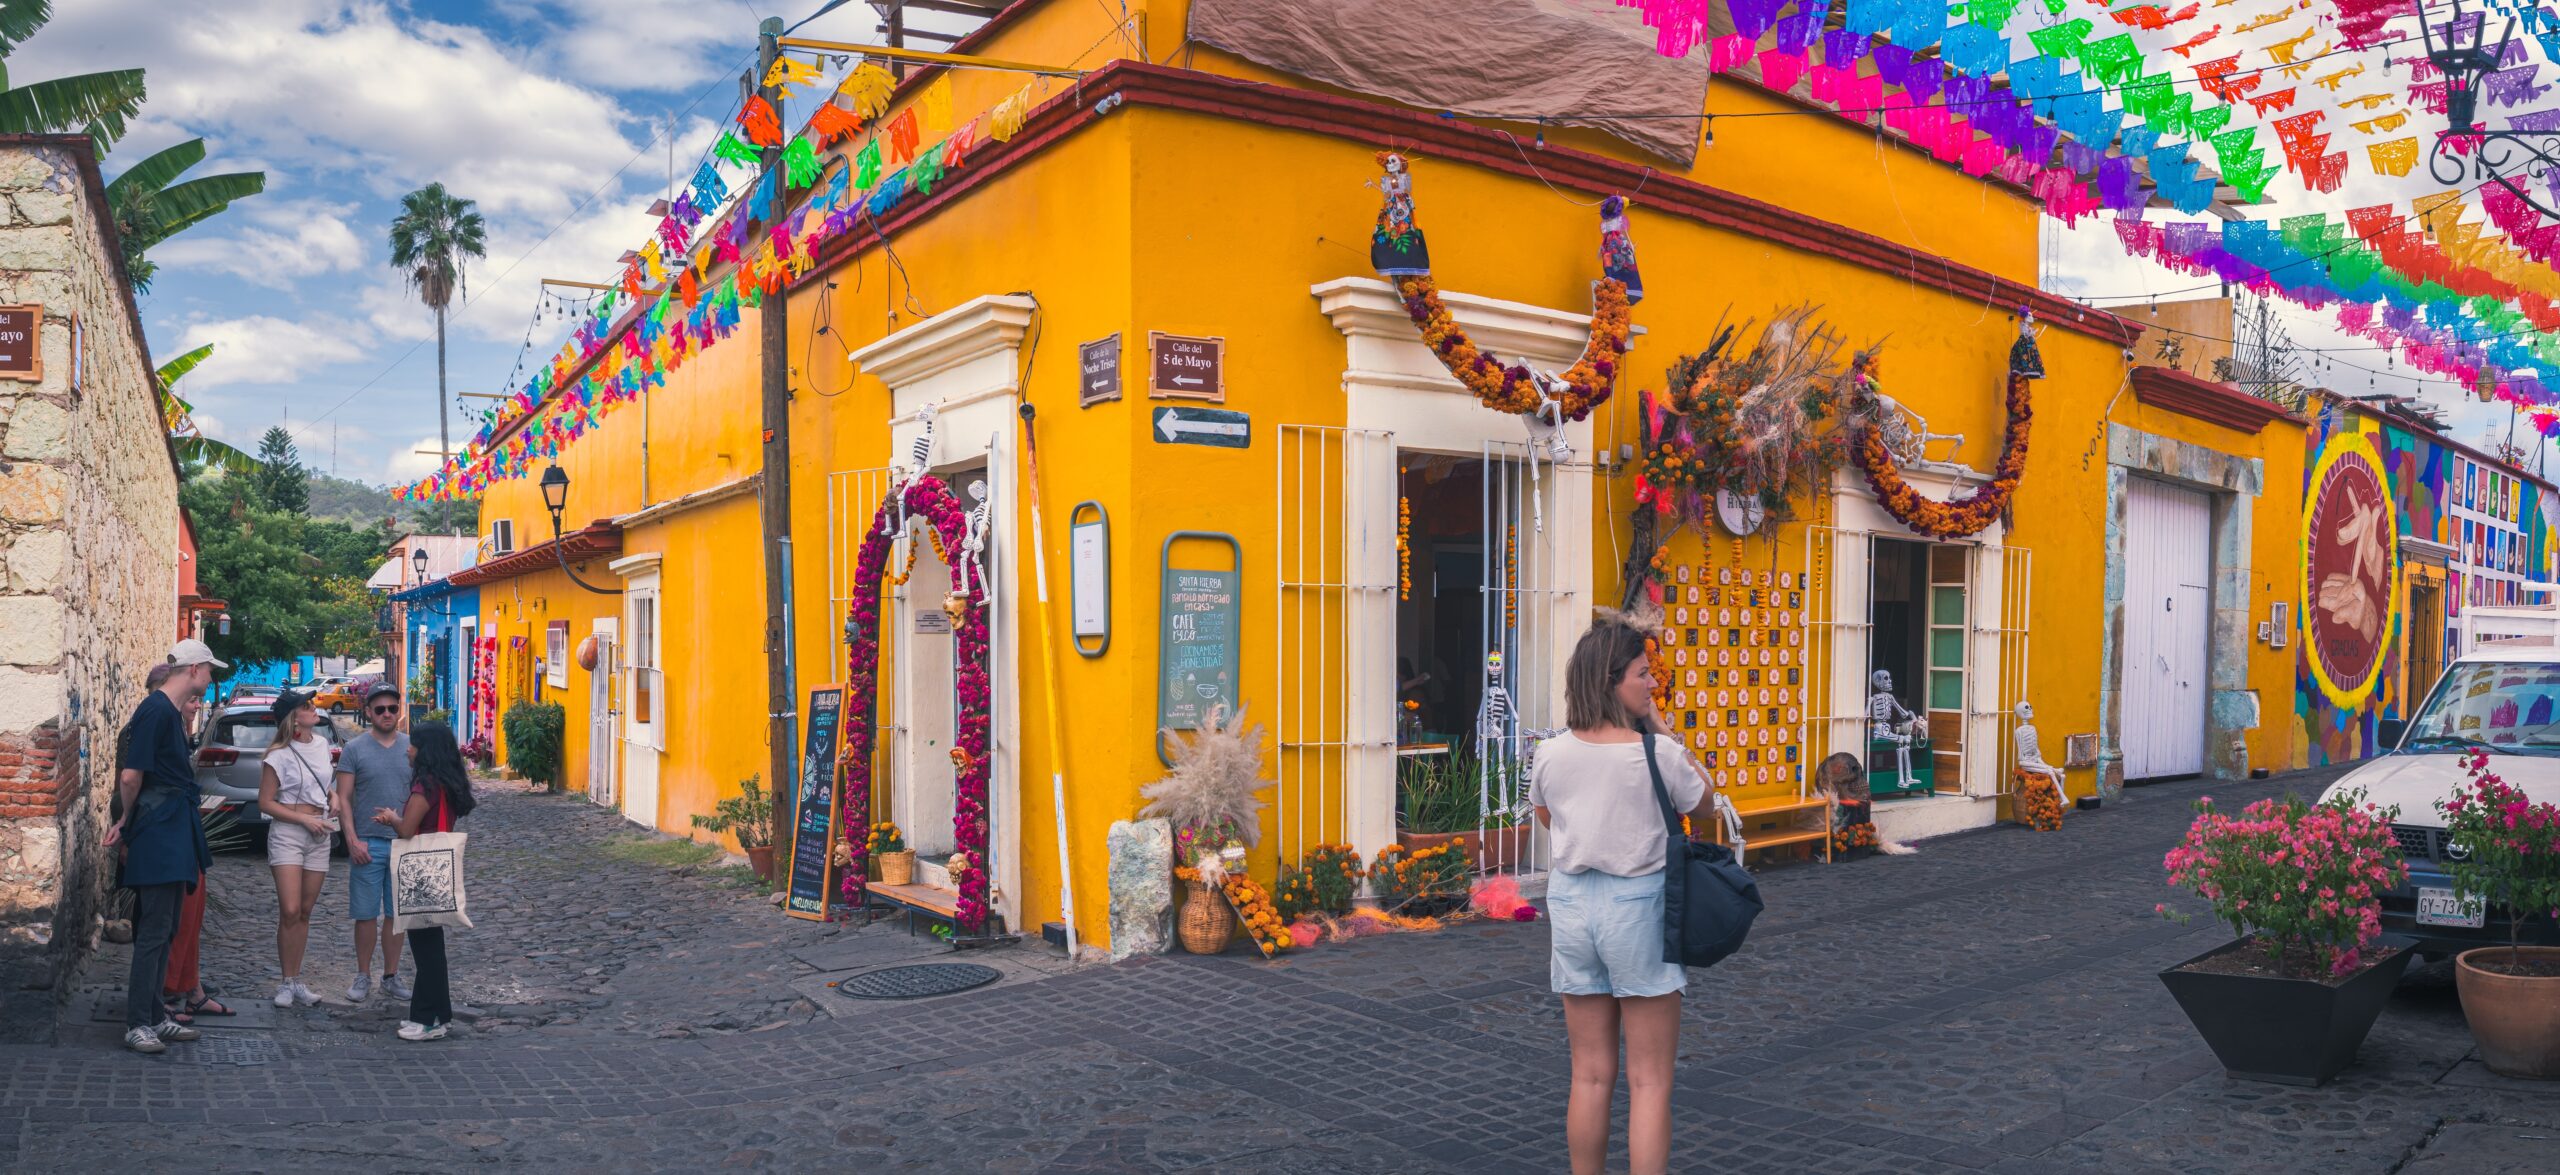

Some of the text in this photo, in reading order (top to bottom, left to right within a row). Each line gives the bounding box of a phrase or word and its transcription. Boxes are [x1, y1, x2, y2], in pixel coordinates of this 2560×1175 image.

[0, 331, 24, 344] ayo
[1172, 342, 1202, 354] Calle del
[1090, 351, 1099, 361] Calle
[1100, 349, 1105, 358] de
[1163, 353, 1212, 370] 5 de Mayo
[1083, 358, 1116, 375] Noche Triste
[2082, 420, 2103, 472] 505
[1178, 576, 1222, 589] SANTA HIERBA
[1180, 656, 1224, 668] HONESTIDAD
